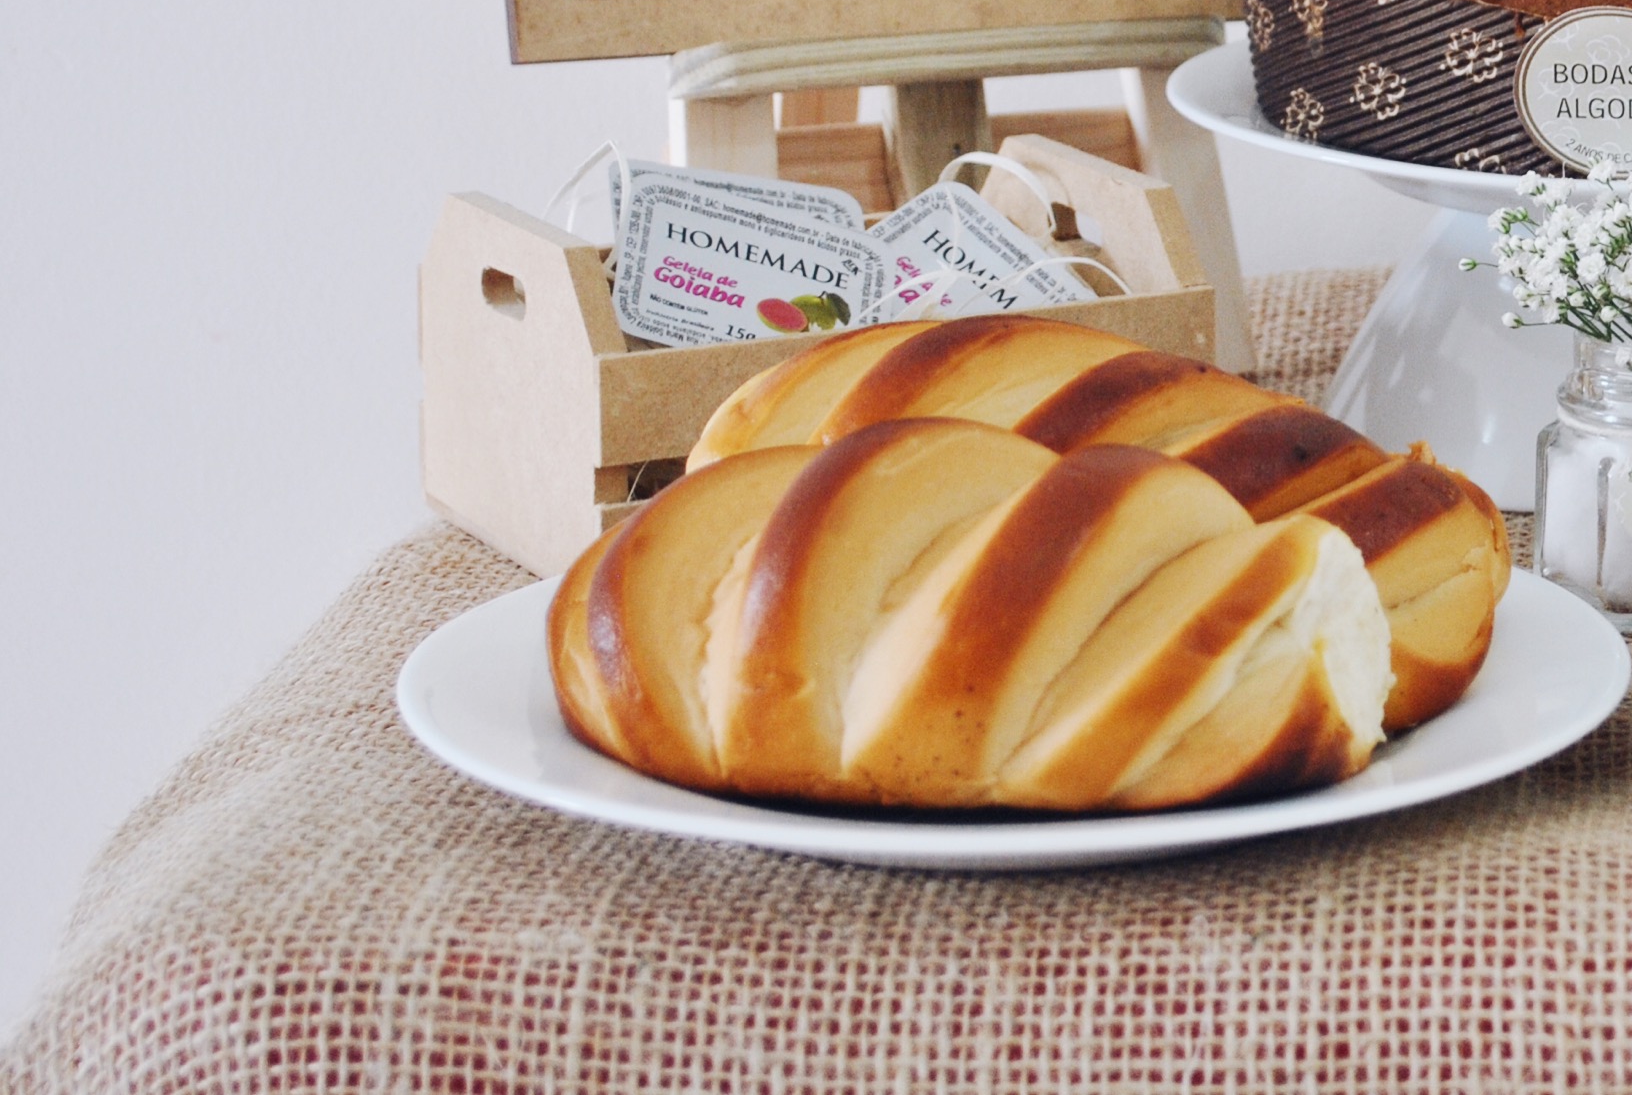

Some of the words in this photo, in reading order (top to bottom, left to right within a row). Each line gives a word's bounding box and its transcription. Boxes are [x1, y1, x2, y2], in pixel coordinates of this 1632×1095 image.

[1566, 138, 1576, 147] 2
[1573, 144, 1603, 160] ANOS
[666, 222, 850, 290] HOMEMADE
[654, 266, 745, 308] Goiaba
[716, 275, 738, 288] de
